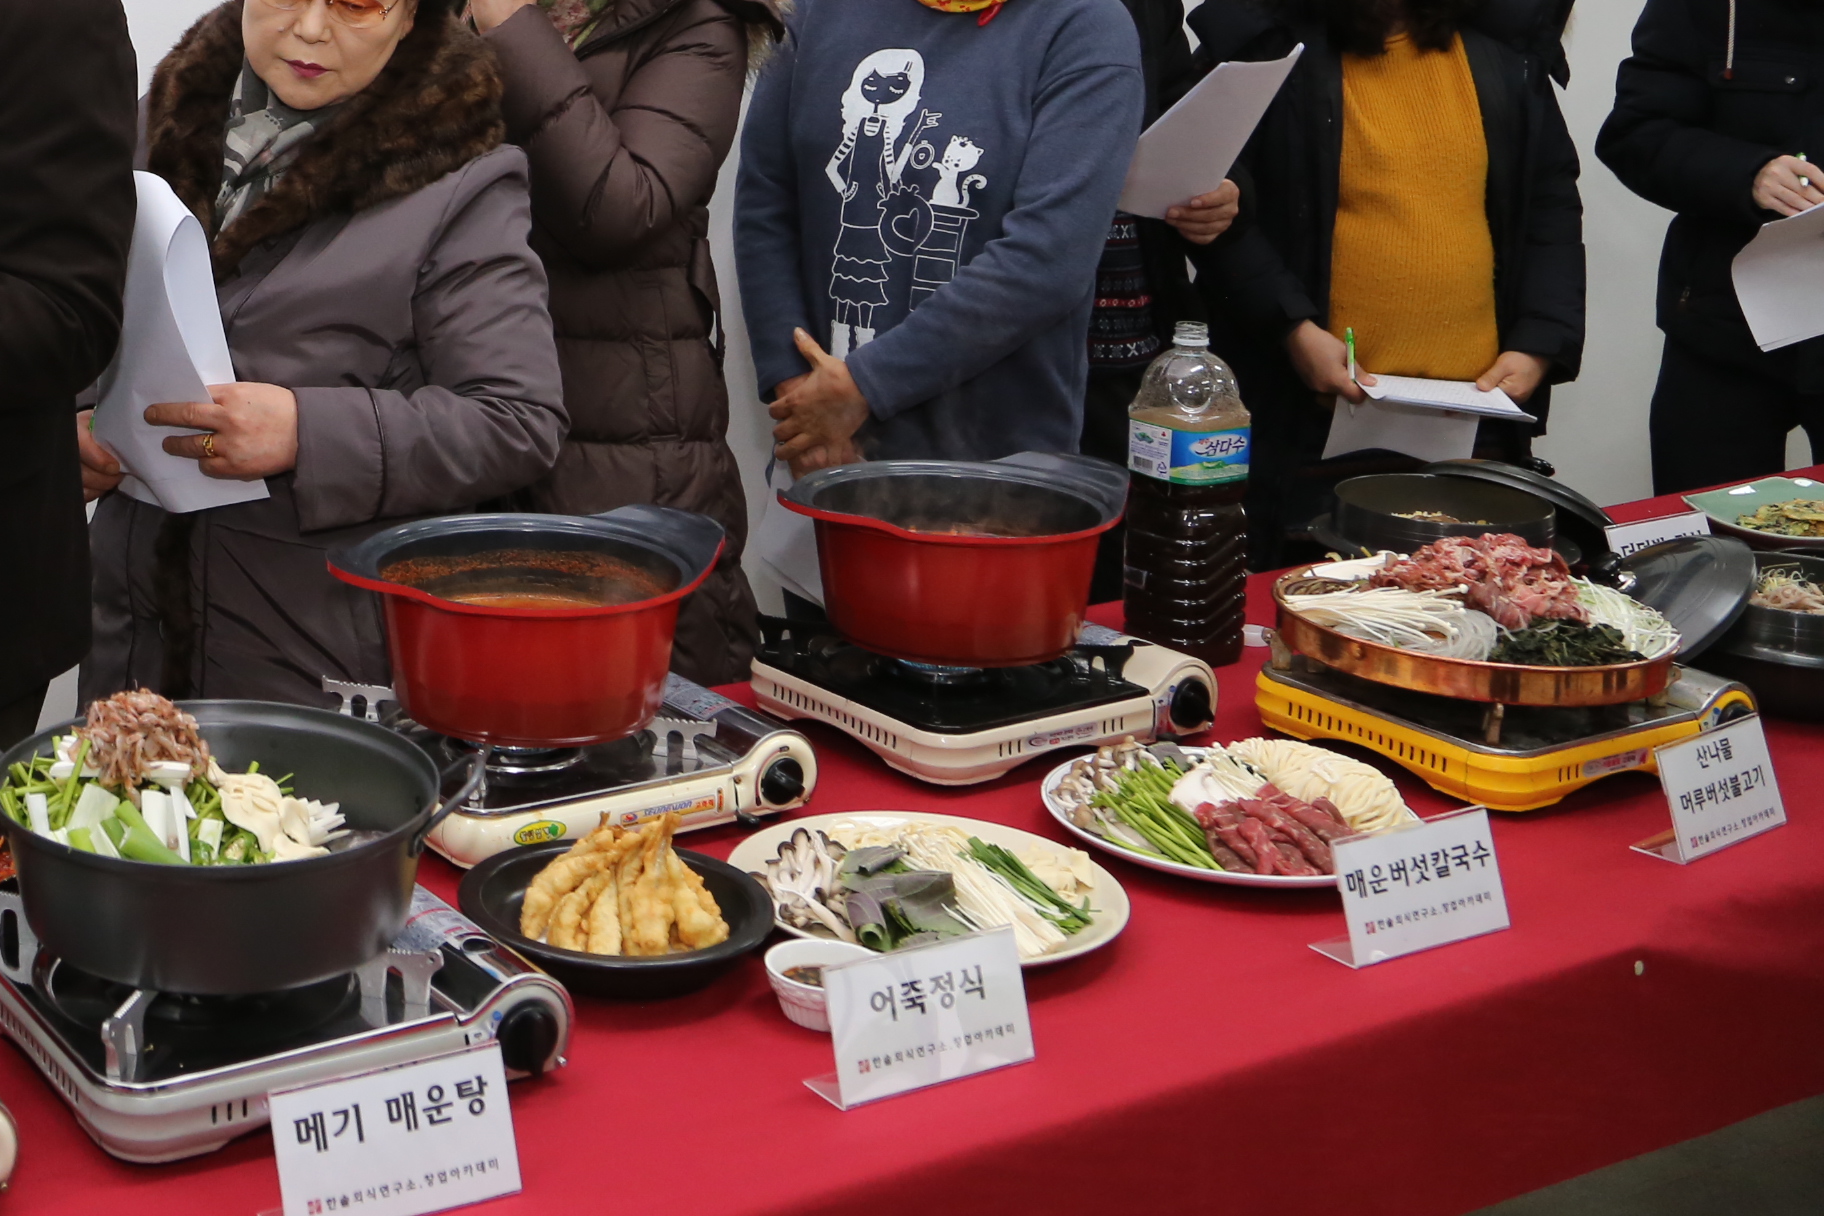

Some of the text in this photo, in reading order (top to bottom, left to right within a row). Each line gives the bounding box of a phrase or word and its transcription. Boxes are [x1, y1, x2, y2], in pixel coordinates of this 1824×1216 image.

[1196, 436, 1246, 457] 삼다수
[1696, 737, 1733, 769] 산나물
[1679, 764, 1766, 814] 머루버섯불고기
[1345, 840, 1491, 899] 매운버섯칼국수
[870, 965, 986, 1022] 어죽정식
[293, 1075, 487, 1153] 메기 매운탕
